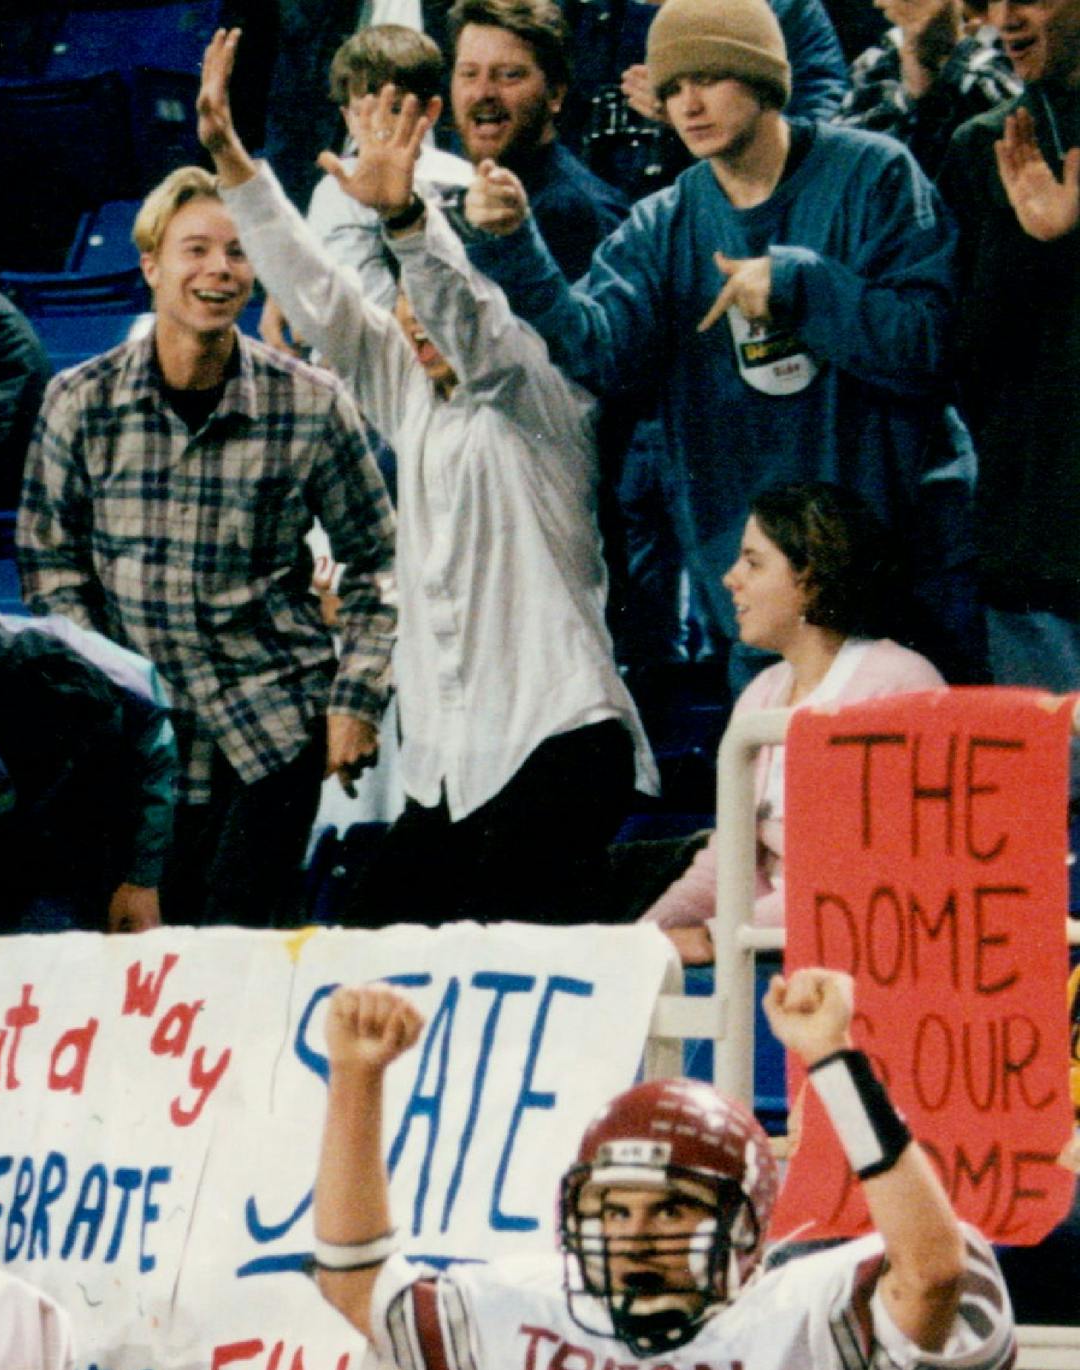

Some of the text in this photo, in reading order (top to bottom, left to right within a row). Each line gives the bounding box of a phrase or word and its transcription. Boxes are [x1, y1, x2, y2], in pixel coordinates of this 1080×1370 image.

[829, 733, 1025, 861] THE
[814, 886, 1029, 994] DOME
[47, 1017, 99, 1094] a
[912, 1013, 1058, 1113] OUR
